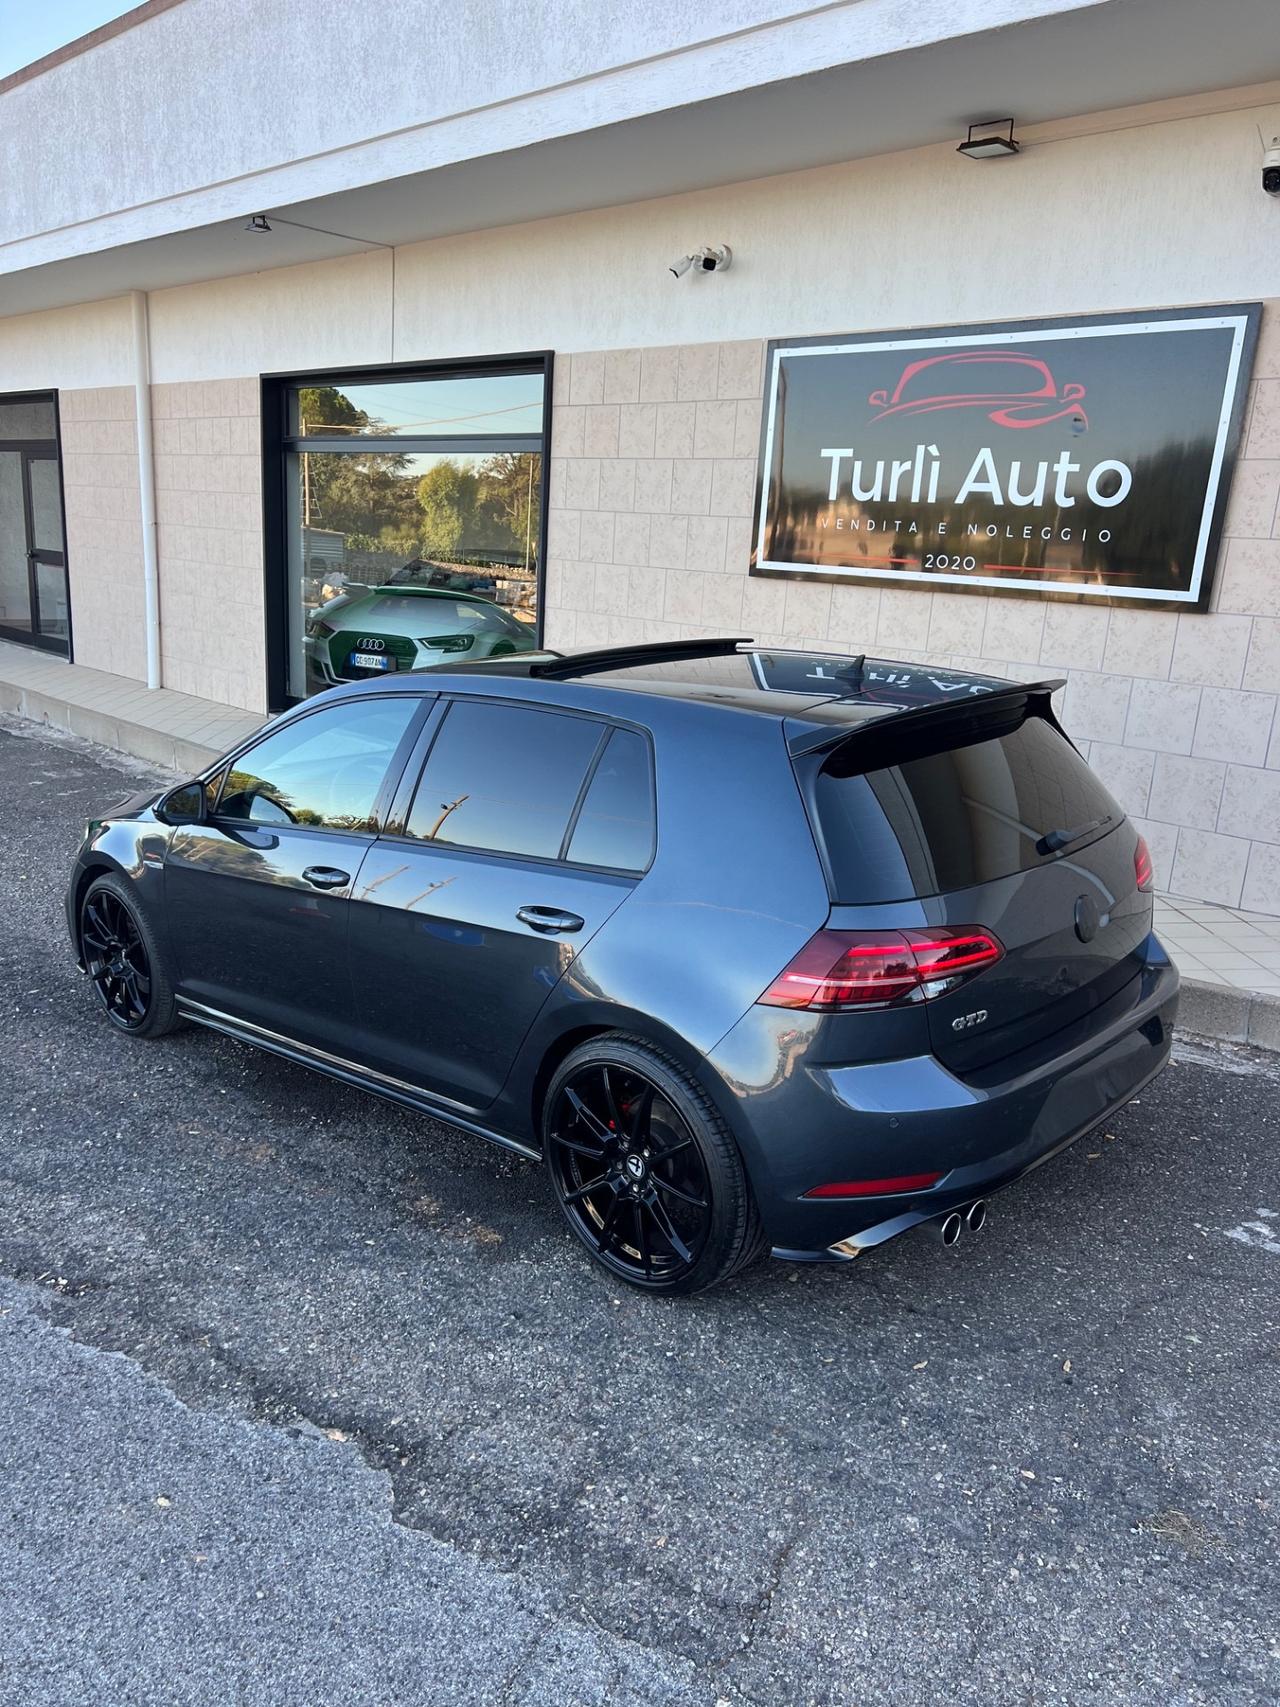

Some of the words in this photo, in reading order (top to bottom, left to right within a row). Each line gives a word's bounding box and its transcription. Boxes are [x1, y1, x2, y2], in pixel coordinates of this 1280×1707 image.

[820, 444, 941, 504] Turlì
[954, 447, 1133, 508] Auto
[821, 518, 918, 533] VENDITA
[938, 522, 947, 535] E
[967, 523, 1111, 543] NOLEGGIO
[924, 554, 976, 571] 2020
[951, 1009, 988, 1031] GTD
